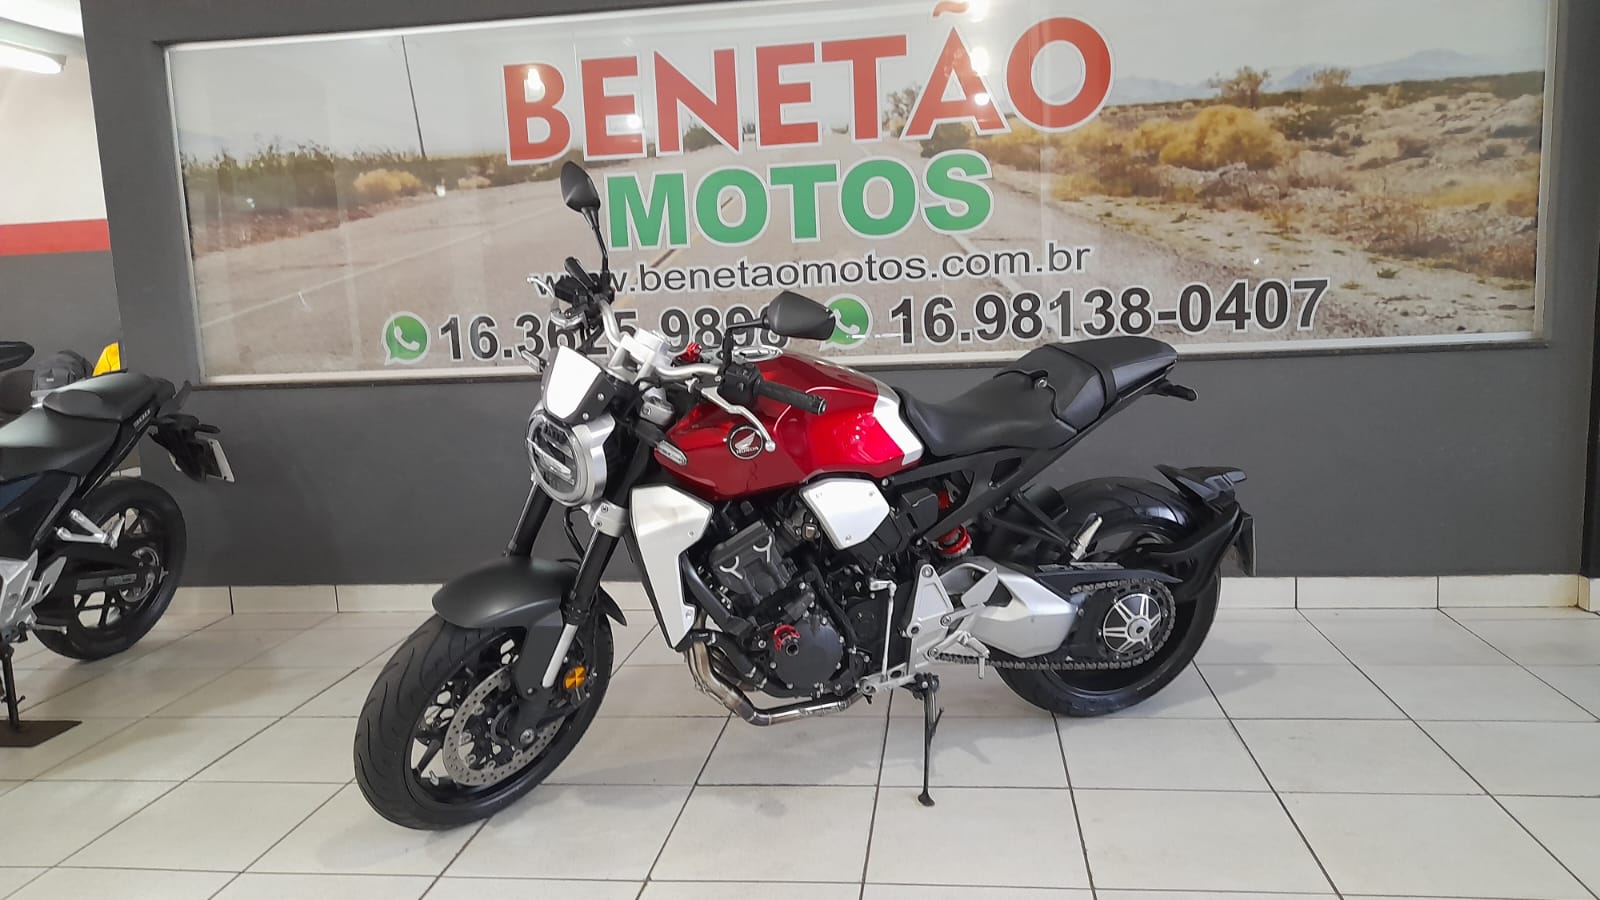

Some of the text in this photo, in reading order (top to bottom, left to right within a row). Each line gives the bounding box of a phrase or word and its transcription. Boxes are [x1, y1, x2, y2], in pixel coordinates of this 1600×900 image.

[503, 1, 1112, 162] BENETÃO
[606, 152, 993, 248] MOTOS
[532, 243, 1090, 295] ww.benetaomotos.com.br
[440, 305, 789, 361] 16.3659898
[891, 279, 1328, 344] 16.98138-0407
